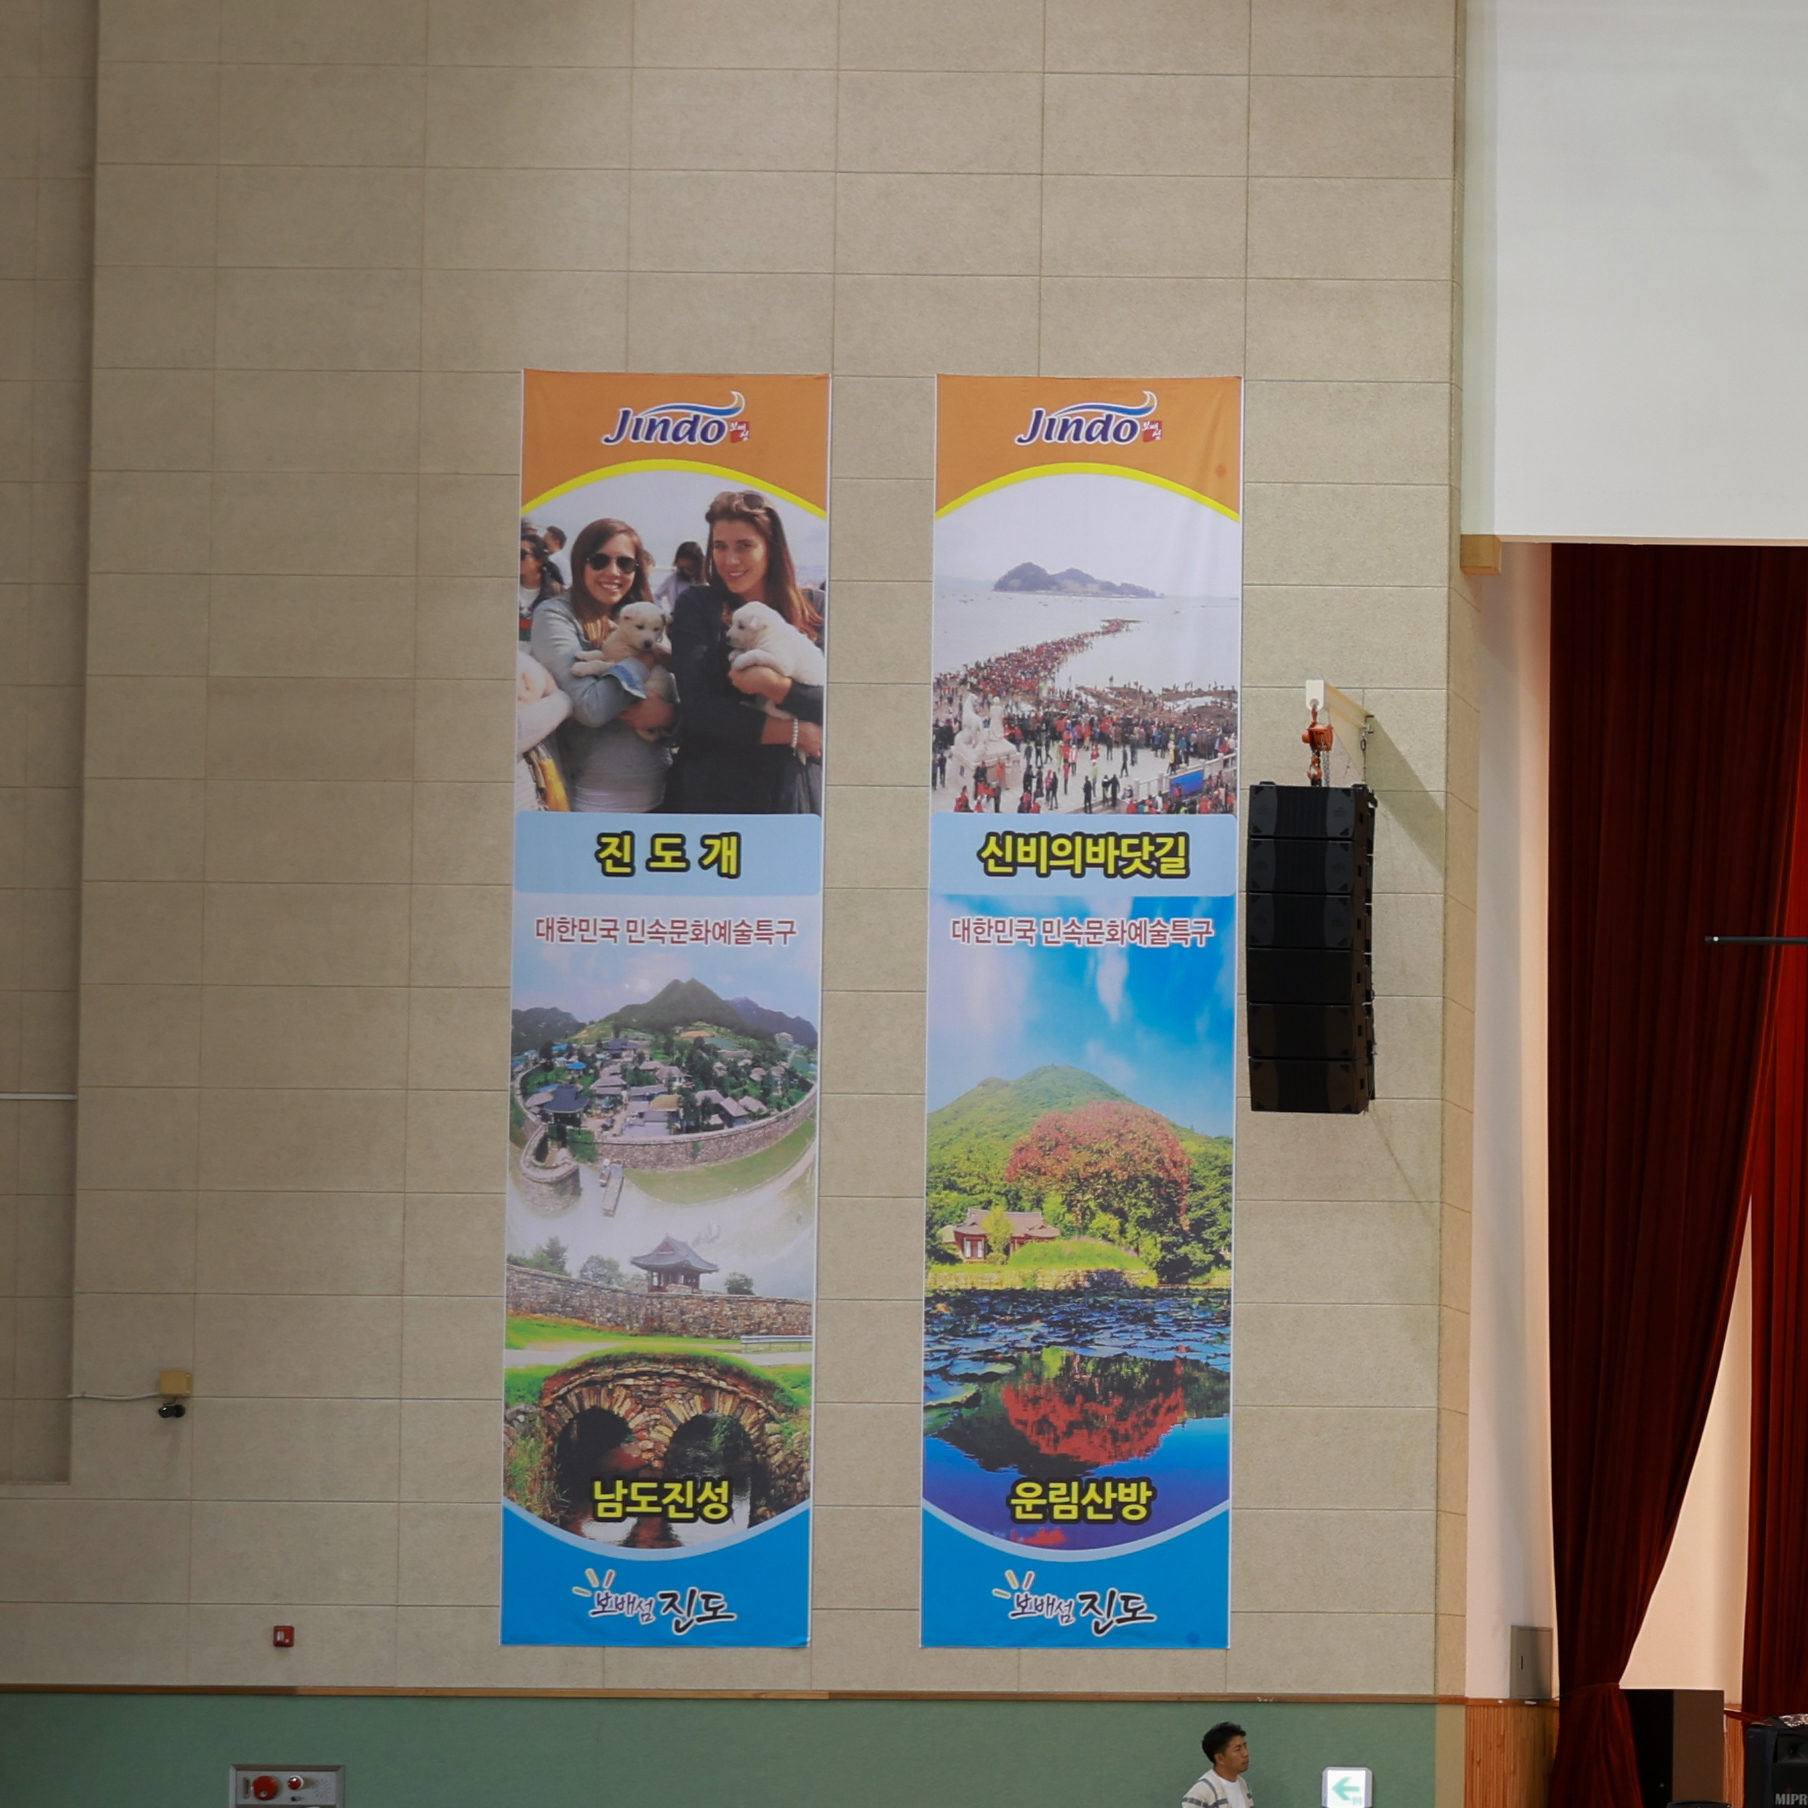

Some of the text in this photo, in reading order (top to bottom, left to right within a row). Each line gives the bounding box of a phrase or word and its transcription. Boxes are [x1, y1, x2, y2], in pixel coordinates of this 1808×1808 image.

[602, 408, 728, 445] Jindo
[1014, 408, 1140, 445] Jindo
[980, 834, 1187, 875] 신비의바닷길
[535, 916, 797, 946] 대한민국 민속문화예술특구
[951, 916, 1214, 947] 대한민국 민속문화예술특구
[593, 1479, 730, 1521] 남도진성
[1010, 1481, 1153, 1521] 운림산방
[589, 1586, 738, 1636] 보배섬 진도
[1009, 1587, 1158, 1637] 보배섬 진도
